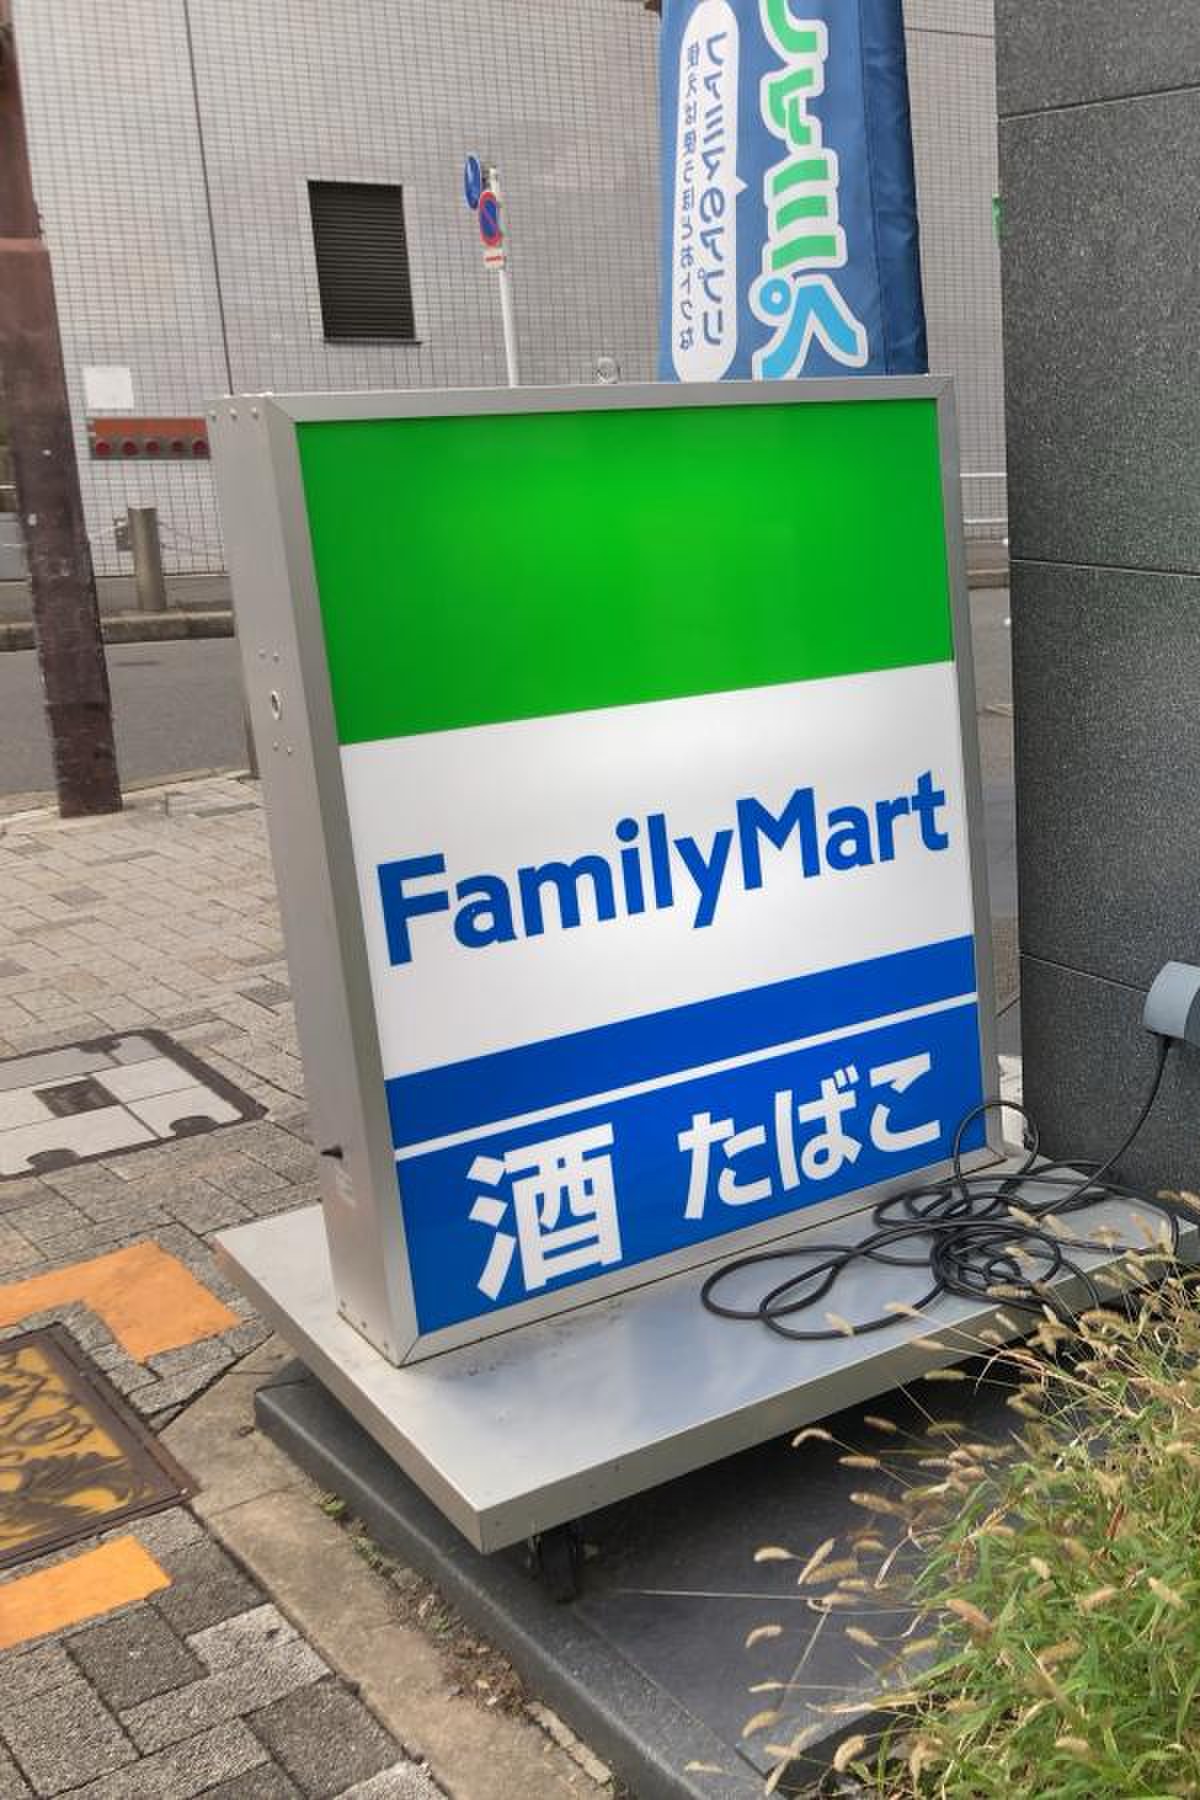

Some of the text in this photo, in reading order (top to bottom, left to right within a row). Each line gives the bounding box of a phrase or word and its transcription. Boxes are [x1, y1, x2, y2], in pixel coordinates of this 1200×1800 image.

[376, 770, 949, 967] FamilyMart
[466, 1051, 942, 1301] 酒 たばこ
